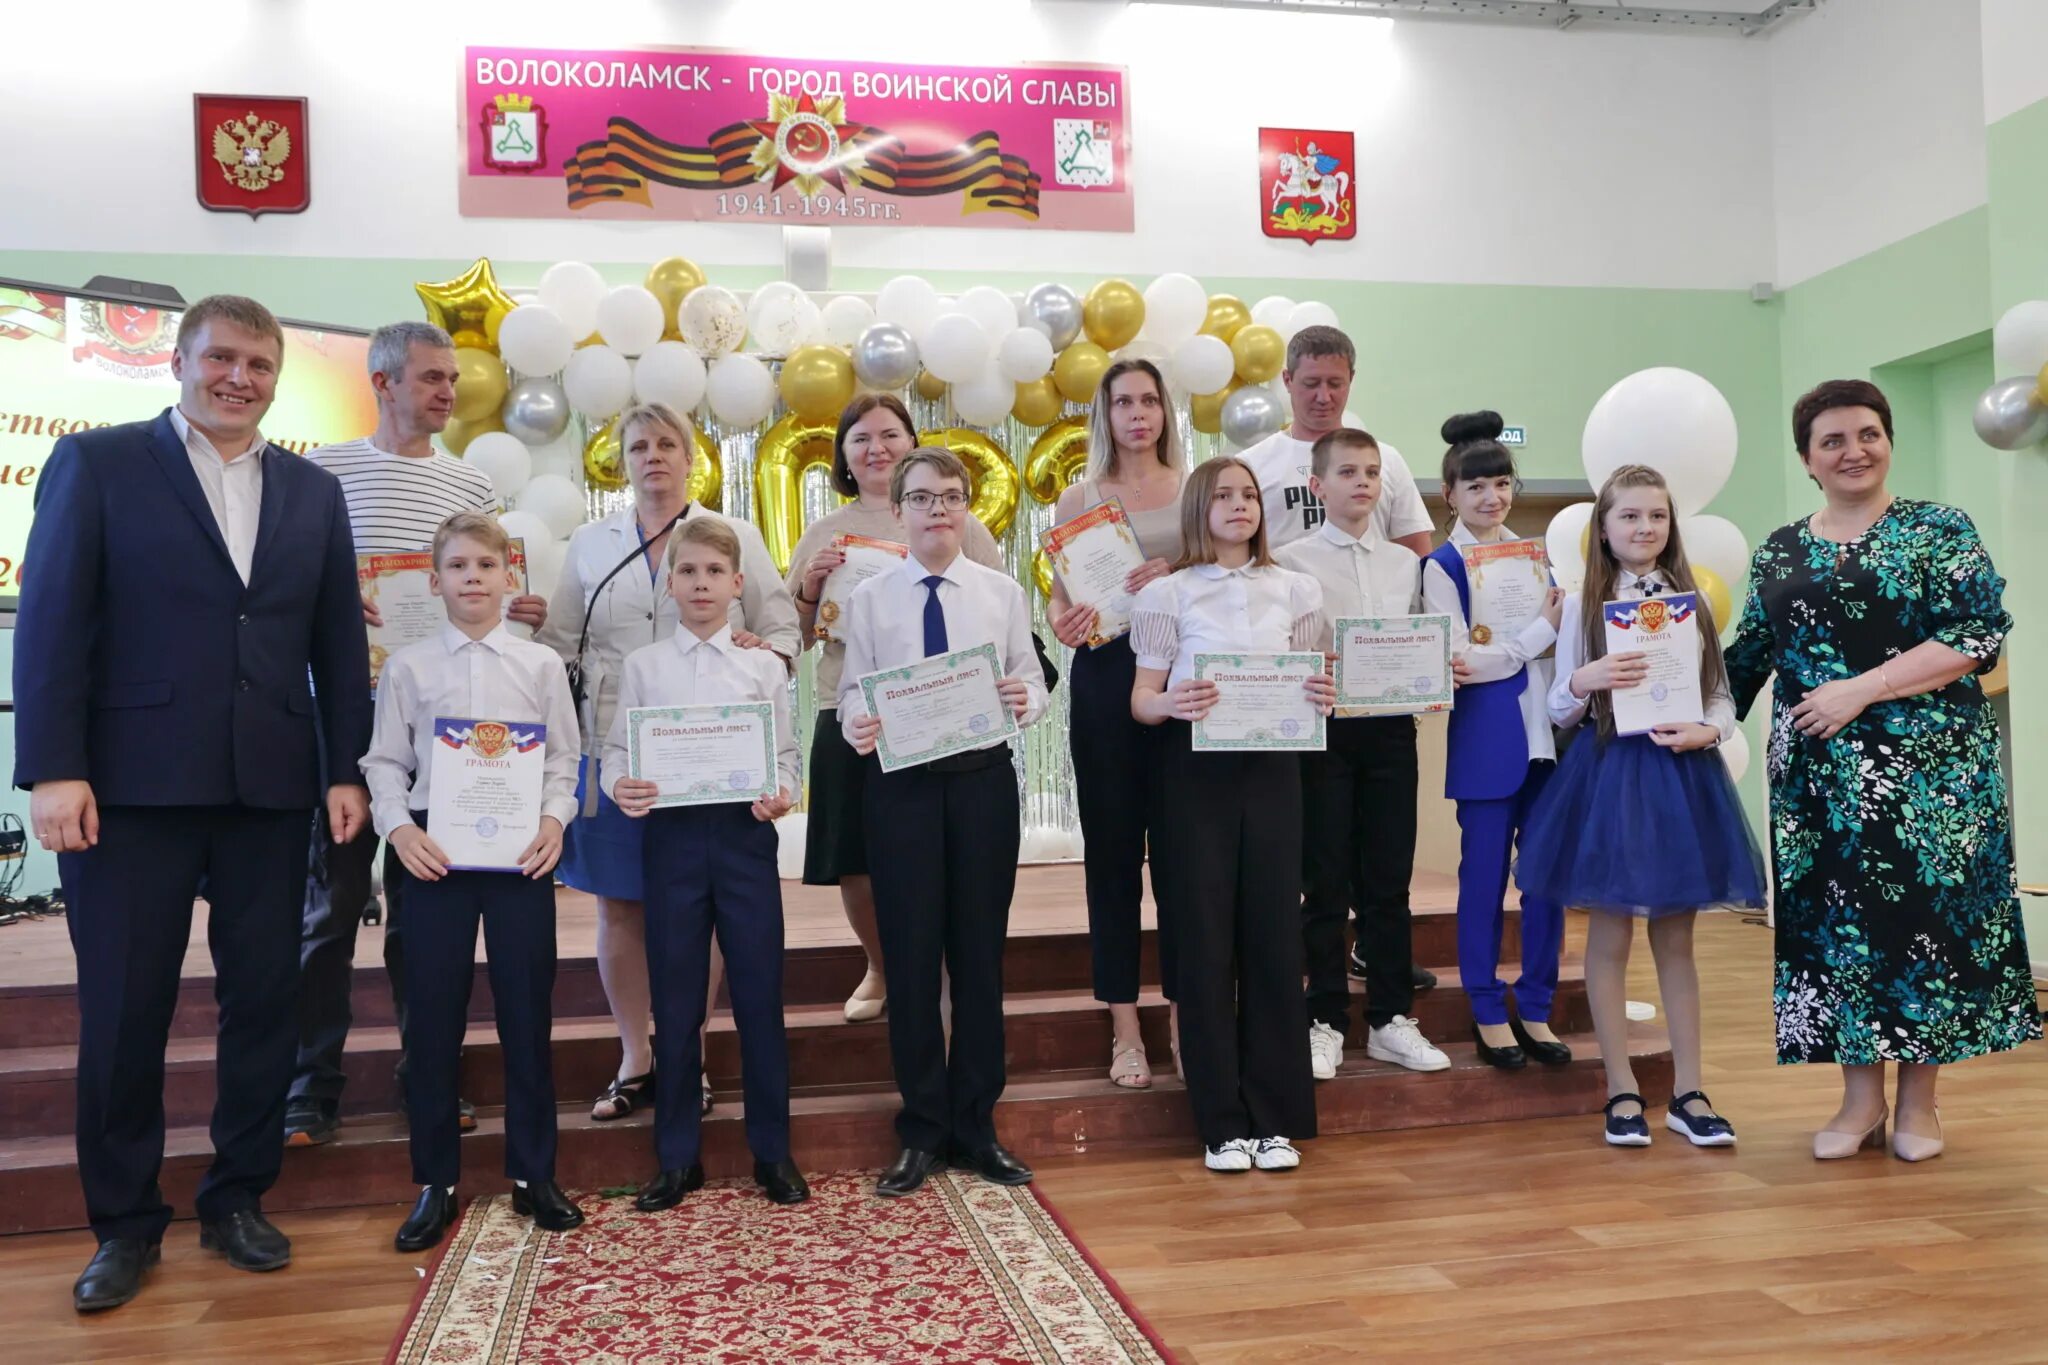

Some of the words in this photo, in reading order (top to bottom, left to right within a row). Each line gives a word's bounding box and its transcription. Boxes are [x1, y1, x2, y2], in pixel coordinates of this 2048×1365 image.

[476, 57, 712, 91] ВОЛОКОЛАМСК
[748, 67, 844, 99] ГОРОД
[853, 71, 1012, 104] ВОИНСКОЙ
[1022, 79, 1116, 107] СЛАВЫ
[717, 193, 902, 220] 1941-1945гг.
[1284, 486, 1324, 510] PU
[465, 758, 511, 769] ГРАМОТА
